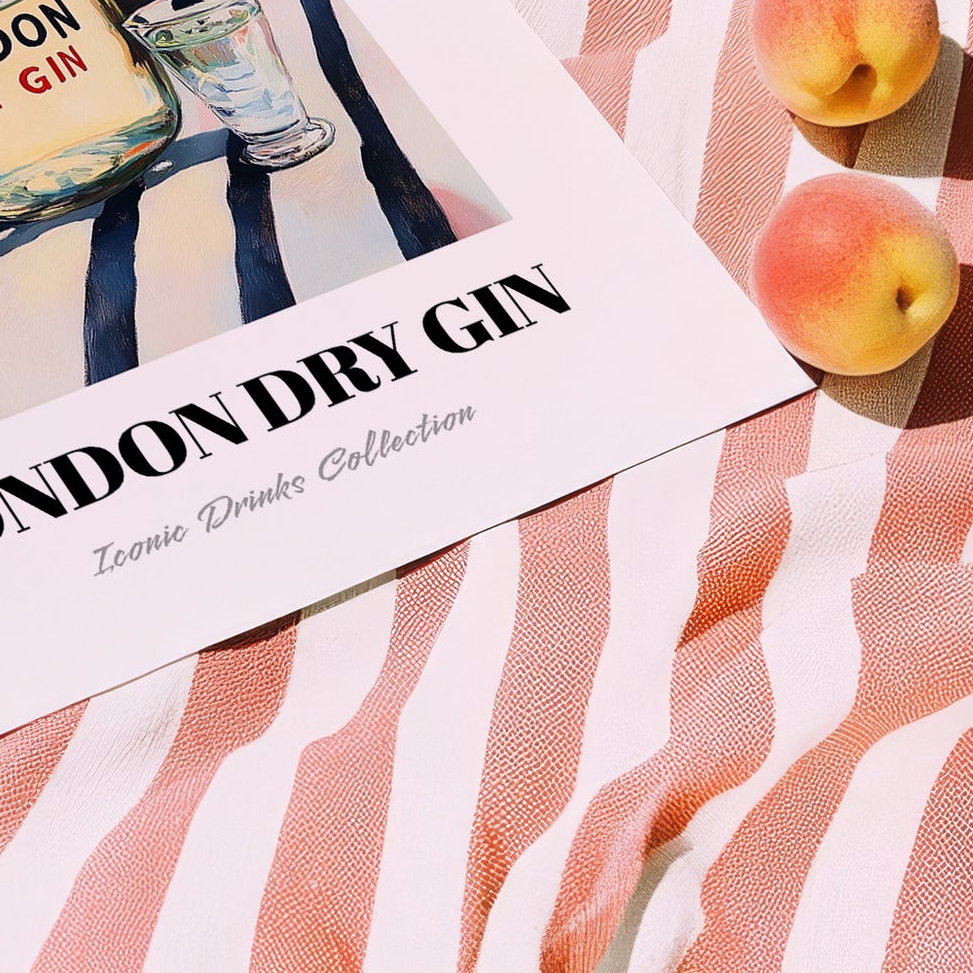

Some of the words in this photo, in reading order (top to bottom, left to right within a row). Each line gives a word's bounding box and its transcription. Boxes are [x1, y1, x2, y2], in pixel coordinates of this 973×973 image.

[18, 45, 88, 94] GIN
[235, 321, 419, 432] DRY
[422, 263, 572, 354] GIN
[92, 523, 190, 578] Iconic
[196, 472, 306, 534] Drinks
[317, 404, 477, 482] Collection
